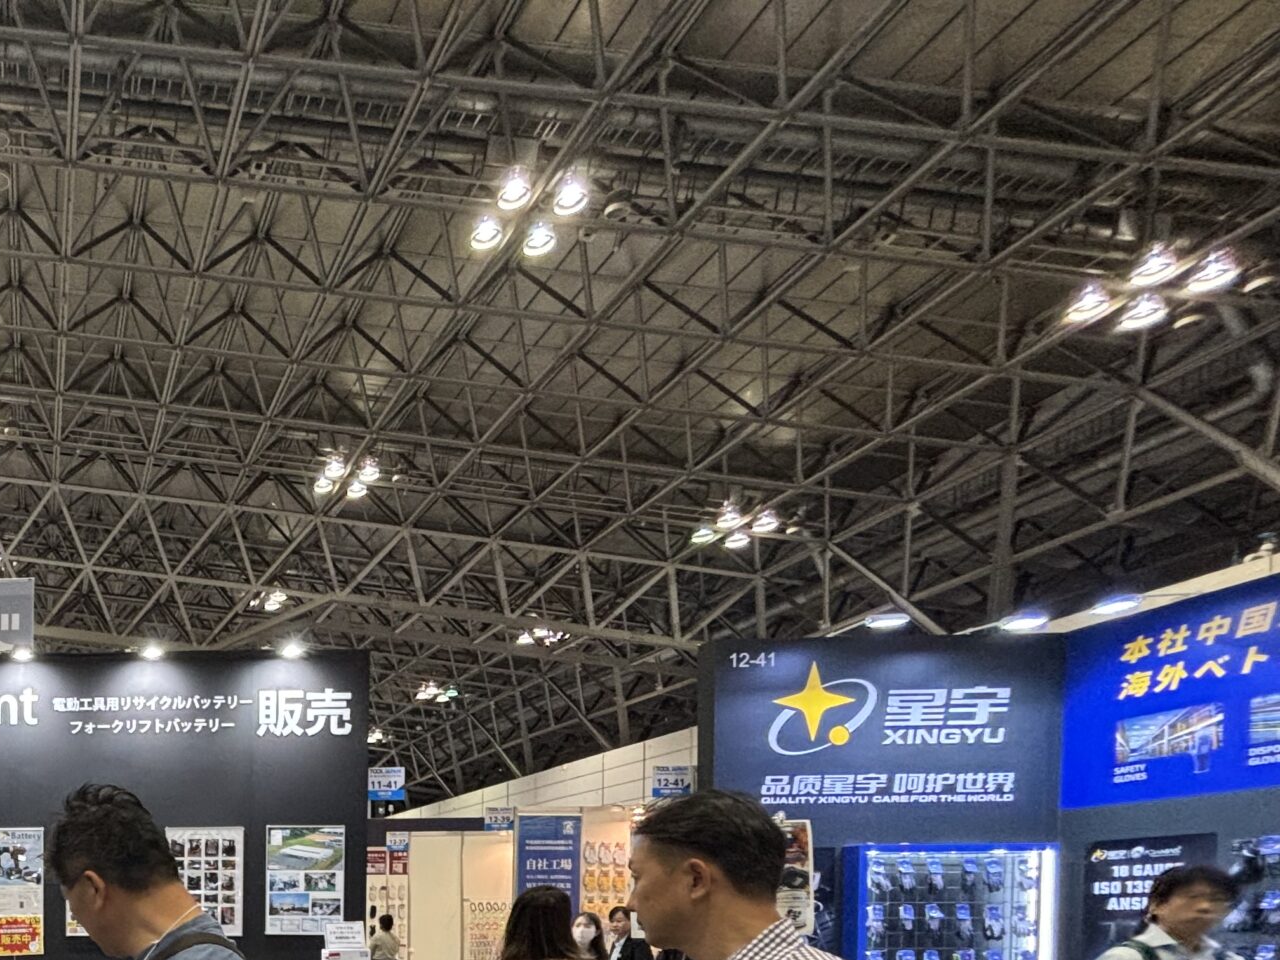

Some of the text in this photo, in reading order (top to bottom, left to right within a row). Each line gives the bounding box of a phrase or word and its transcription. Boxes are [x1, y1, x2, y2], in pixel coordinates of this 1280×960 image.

[1119, 601, 1280, 664] 本社中国
[729, 652, 776, 668] 12-41
[52, 695, 253, 712] 電動工具用リサイクルバッテリー
[884, 686, 1012, 727] 星宇
[257, 688, 353, 737] 販売
[70, 717, 236, 735] フォークリフトバッテリー
[881, 728, 1007, 745] XINGYU
[1113, 763, 1147, 775] SAFETY
[370, 780, 398, 789] 11-41
[656, 778, 685, 787] 12-41
[761, 771, 1016, 796] 品质星宇 呵护世界
[1113, 772, 1147, 784] GLOVES
[761, 794, 1014, 805] QUALITY XINGYU CARE FOR THE WORLD
[11, 832, 42, 841] Battery
[526, 858, 573, 872] 自社工場
[1093, 881, 1122, 895] ISO
[0, 934, 32, 945] 販売中
